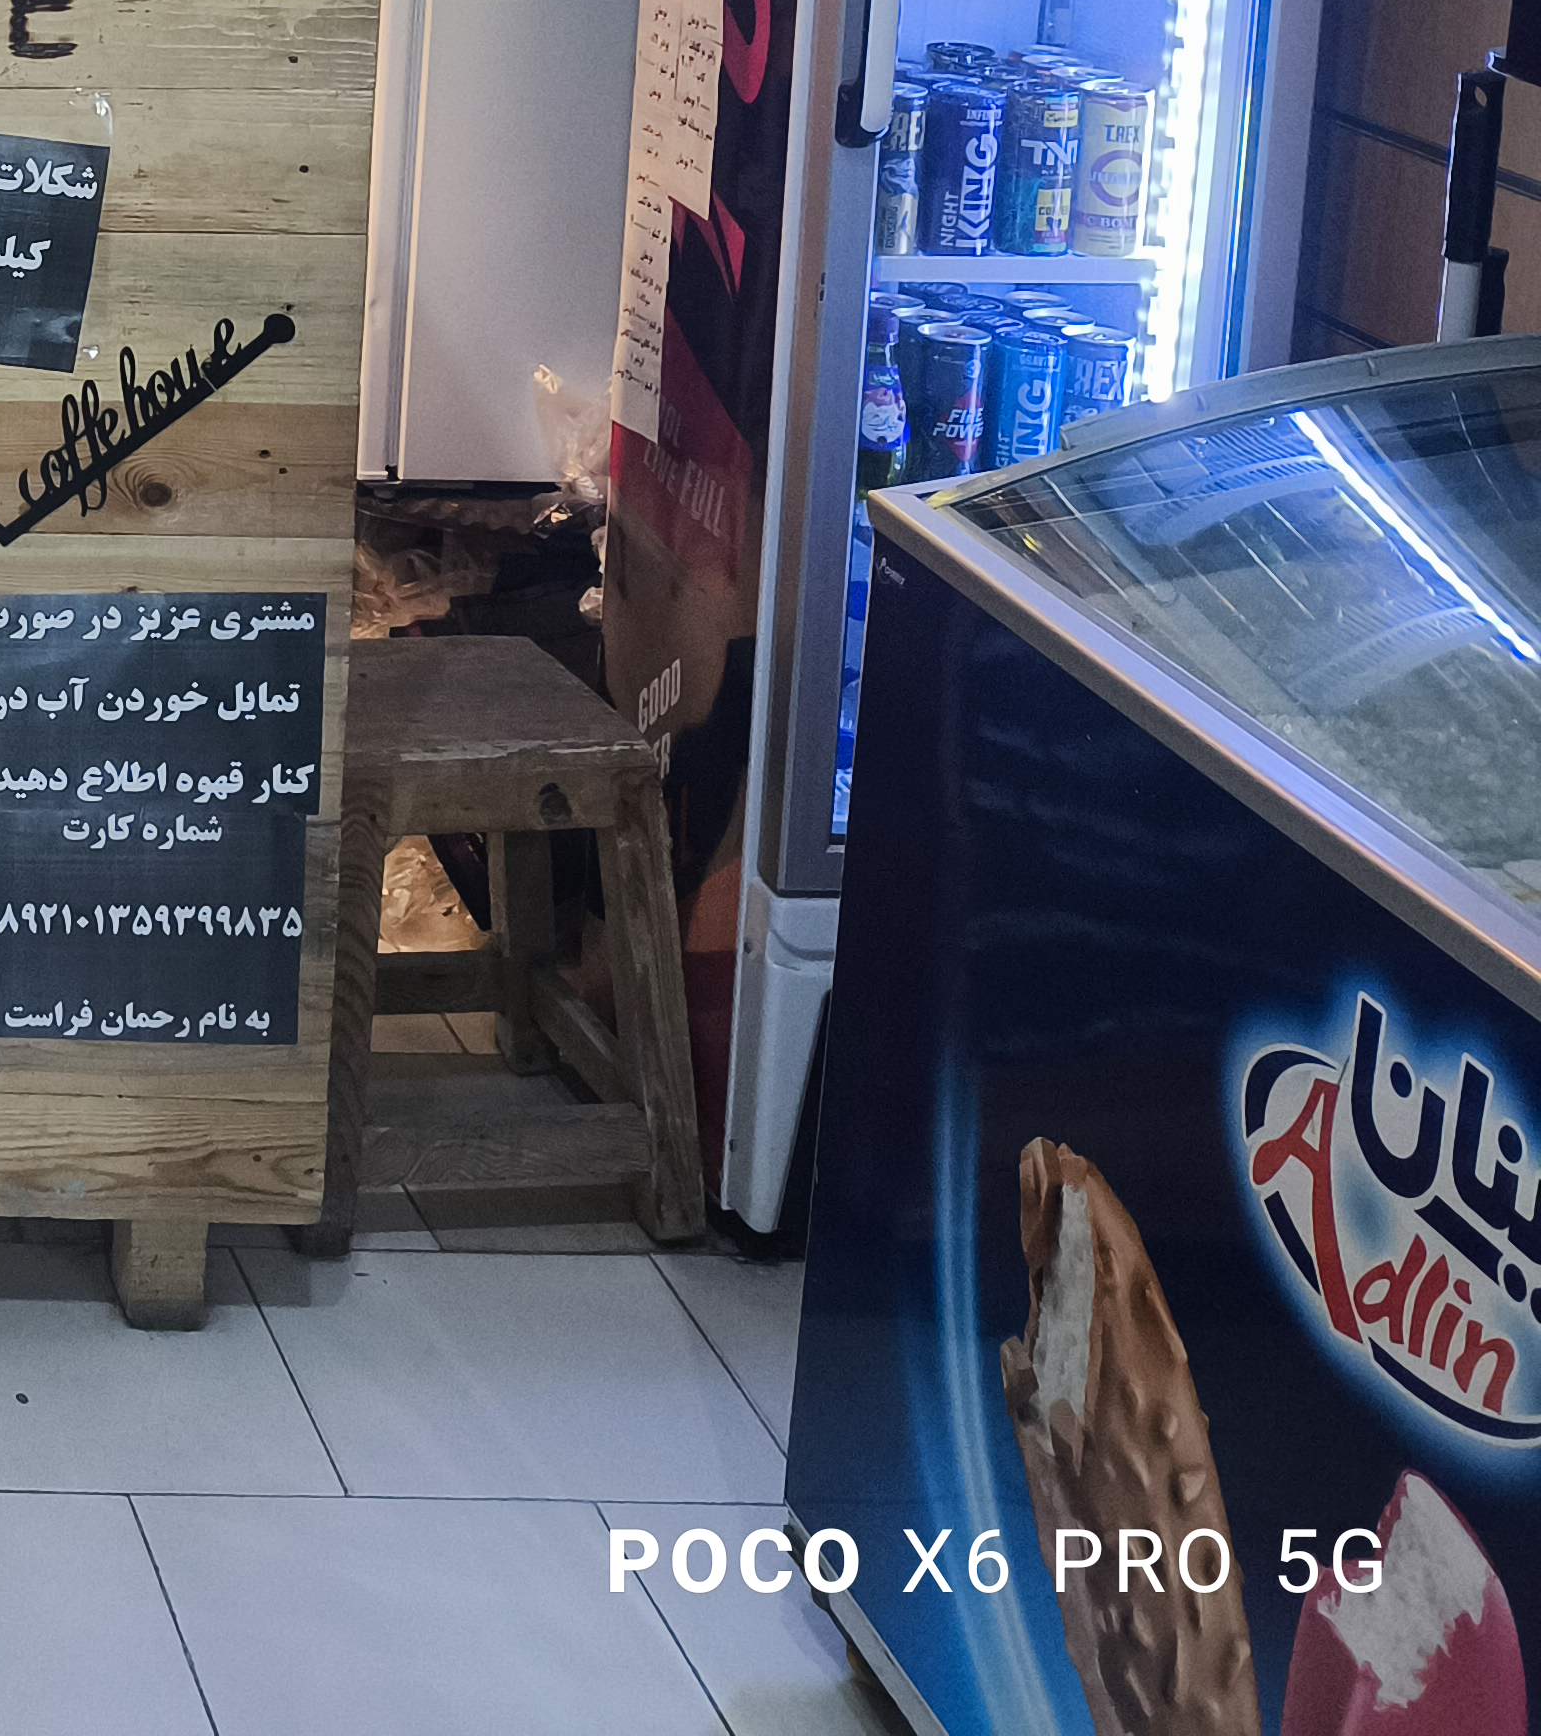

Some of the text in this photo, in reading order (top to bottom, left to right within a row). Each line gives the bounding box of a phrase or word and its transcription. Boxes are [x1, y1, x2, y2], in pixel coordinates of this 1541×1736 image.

[939, 190, 959, 247] NIGHT
[82, 604, 121, 640] در
[129, 605, 201, 641] عزیز
[210, 600, 315, 640] مشتری
[37, 677, 90, 721] آب
[97, 681, 209, 722] خوردن
[217, 681, 301, 722] تمایل
[76, 760, 167, 802] اطلاع
[175, 761, 244, 803] قهوه
[251, 762, 315, 804] کنار
[62, 814, 223, 851] شماره کارت
[4, 1001, 271, 1037] به نام رحمان فراست
[1251, 1078, 1519, 1418] Adlin
